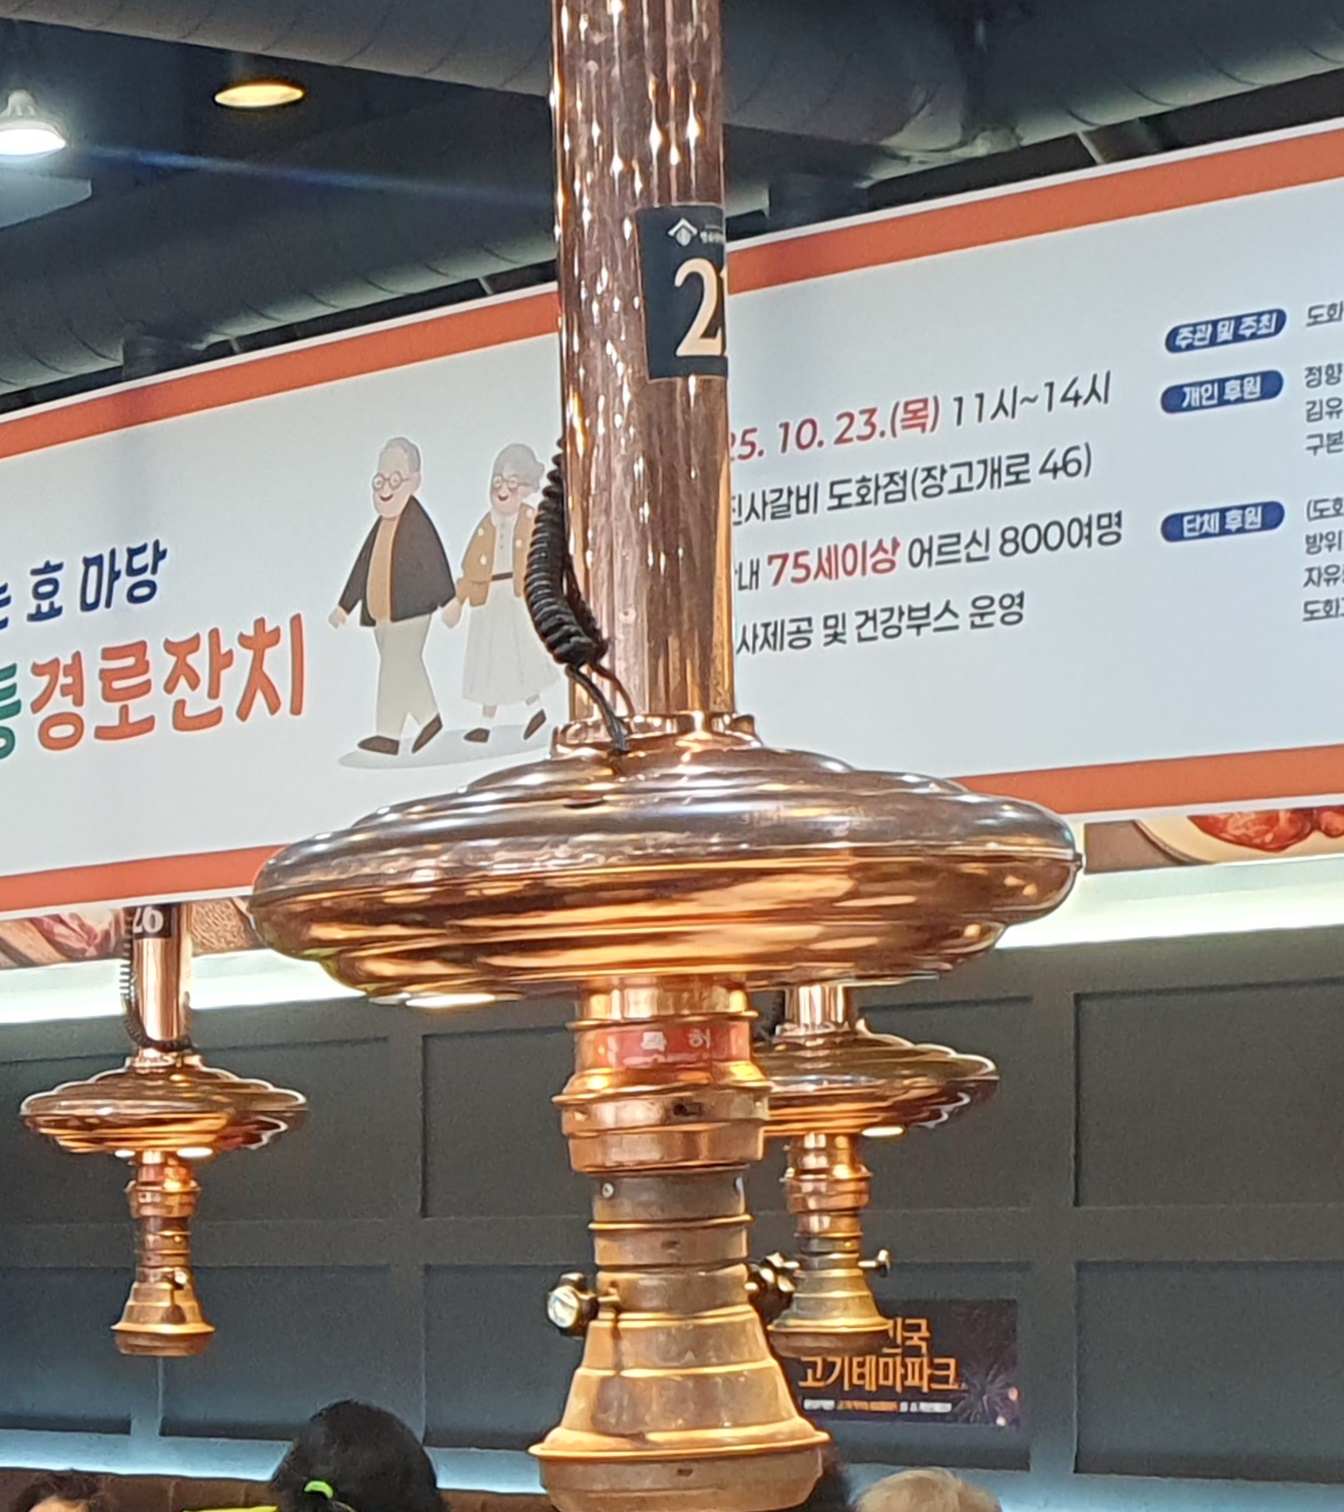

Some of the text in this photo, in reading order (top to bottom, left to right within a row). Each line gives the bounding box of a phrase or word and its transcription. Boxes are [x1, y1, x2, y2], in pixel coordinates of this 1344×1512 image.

[673, 256, 728, 357] 2
[1238, 312, 1278, 339] 주최
[778, 418, 825, 454] 10.
[833, 395, 940, 446] 23.(목)
[953, 370, 1111, 427] 11시~14시
[1181, 375, 1262, 409] 개인 후원
[1306, 397, 1344, 423] 김유
[826, 452, 1032, 512] 도화점(장고개로
[1038, 441, 1093, 481] 46)
[1182, 505, 1263, 538] 단체 후원
[735, 509, 1123, 592] 내 75세이상 어르신 800여명
[26, 559, 65, 623] 효
[79, 538, 168, 613] 마당
[1303, 564, 1344, 588] 자유
[822, 612, 847, 648] 및
[854, 598, 961, 645] 건강부스
[968, 590, 1026, 631] 운영
[797, 1355, 962, 1394] 고기테마파크
